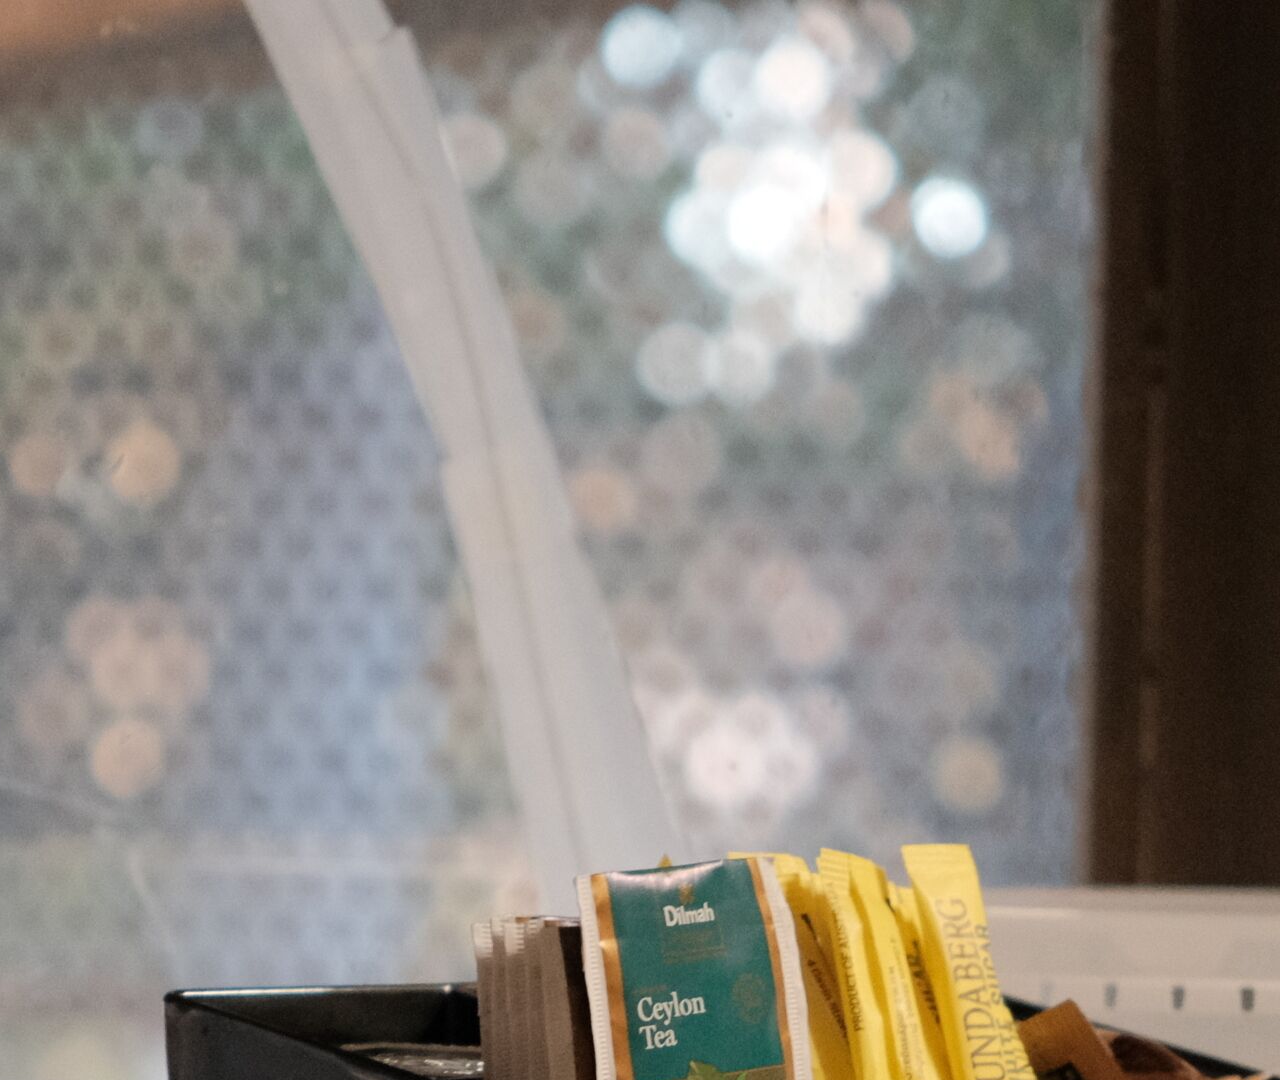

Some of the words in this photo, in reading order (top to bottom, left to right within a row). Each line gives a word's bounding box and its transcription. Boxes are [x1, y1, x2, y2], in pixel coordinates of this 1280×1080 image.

[663, 902, 715, 927] Dilmah
[637, 991, 706, 1025] Ceylon
[639, 1024, 678, 1050] Tea
